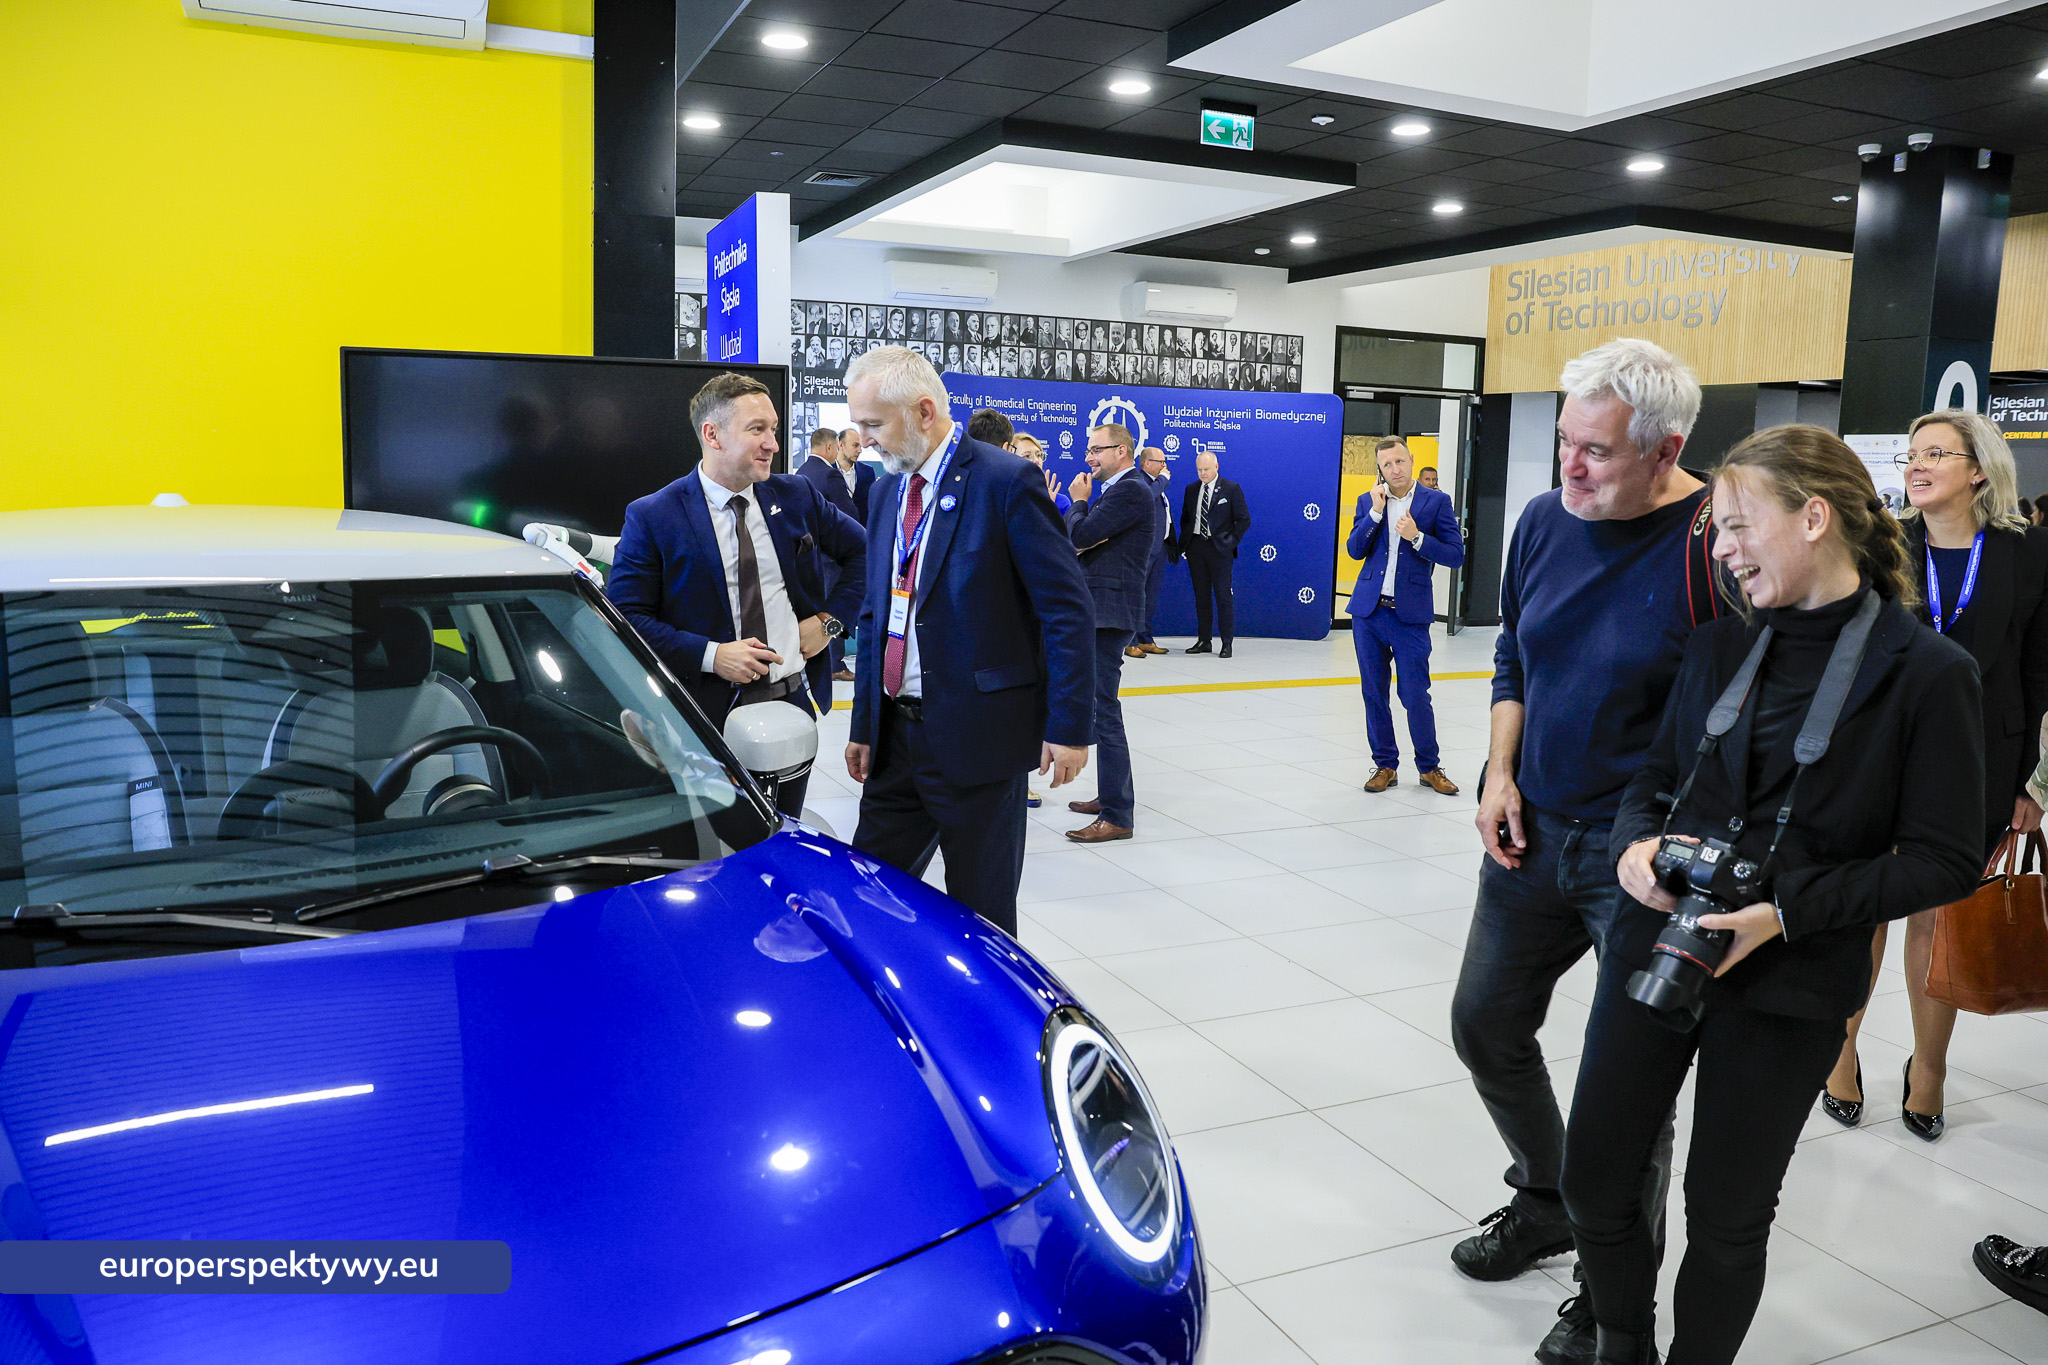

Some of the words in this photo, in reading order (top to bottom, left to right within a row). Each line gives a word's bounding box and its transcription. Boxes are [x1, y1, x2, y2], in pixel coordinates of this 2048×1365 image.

[714, 238, 747, 280] Politechnika
[1507, 264, 1610, 301] Silesian
[1625, 247, 1800, 287] University
[721, 282, 740, 316] Śląska
[1506, 301, 1535, 335] of
[1542, 288, 1727, 331] Technology
[804, 375, 840, 387] Silesian
[804, 386, 814, 395] of
[948, 392, 974, 409] Faculty
[976, 395, 983, 406] of
[985, 396, 1025, 410] Biomedical
[1028, 398, 1077, 415] Engineering
[1991, 396, 2045, 409] Silesian
[999, 411, 1029, 424] iversity
[1031, 412, 1037, 422] of
[1039, 411, 1077, 426] Technology
[1163, 405, 1203, 419] Wydział
[1206, 407, 1251, 421] Inżynierii
[1255, 408, 1327, 424] Biomedycznej
[1991, 409, 2008, 422] of
[1163, 419, 1211, 429] Politechnika
[1213, 418, 1241, 431] Śląska
[2003, 431, 2042, 439] CENTRUM
[1693, 502, 1712, 536] Can
[135, 780, 153, 790] MINI
